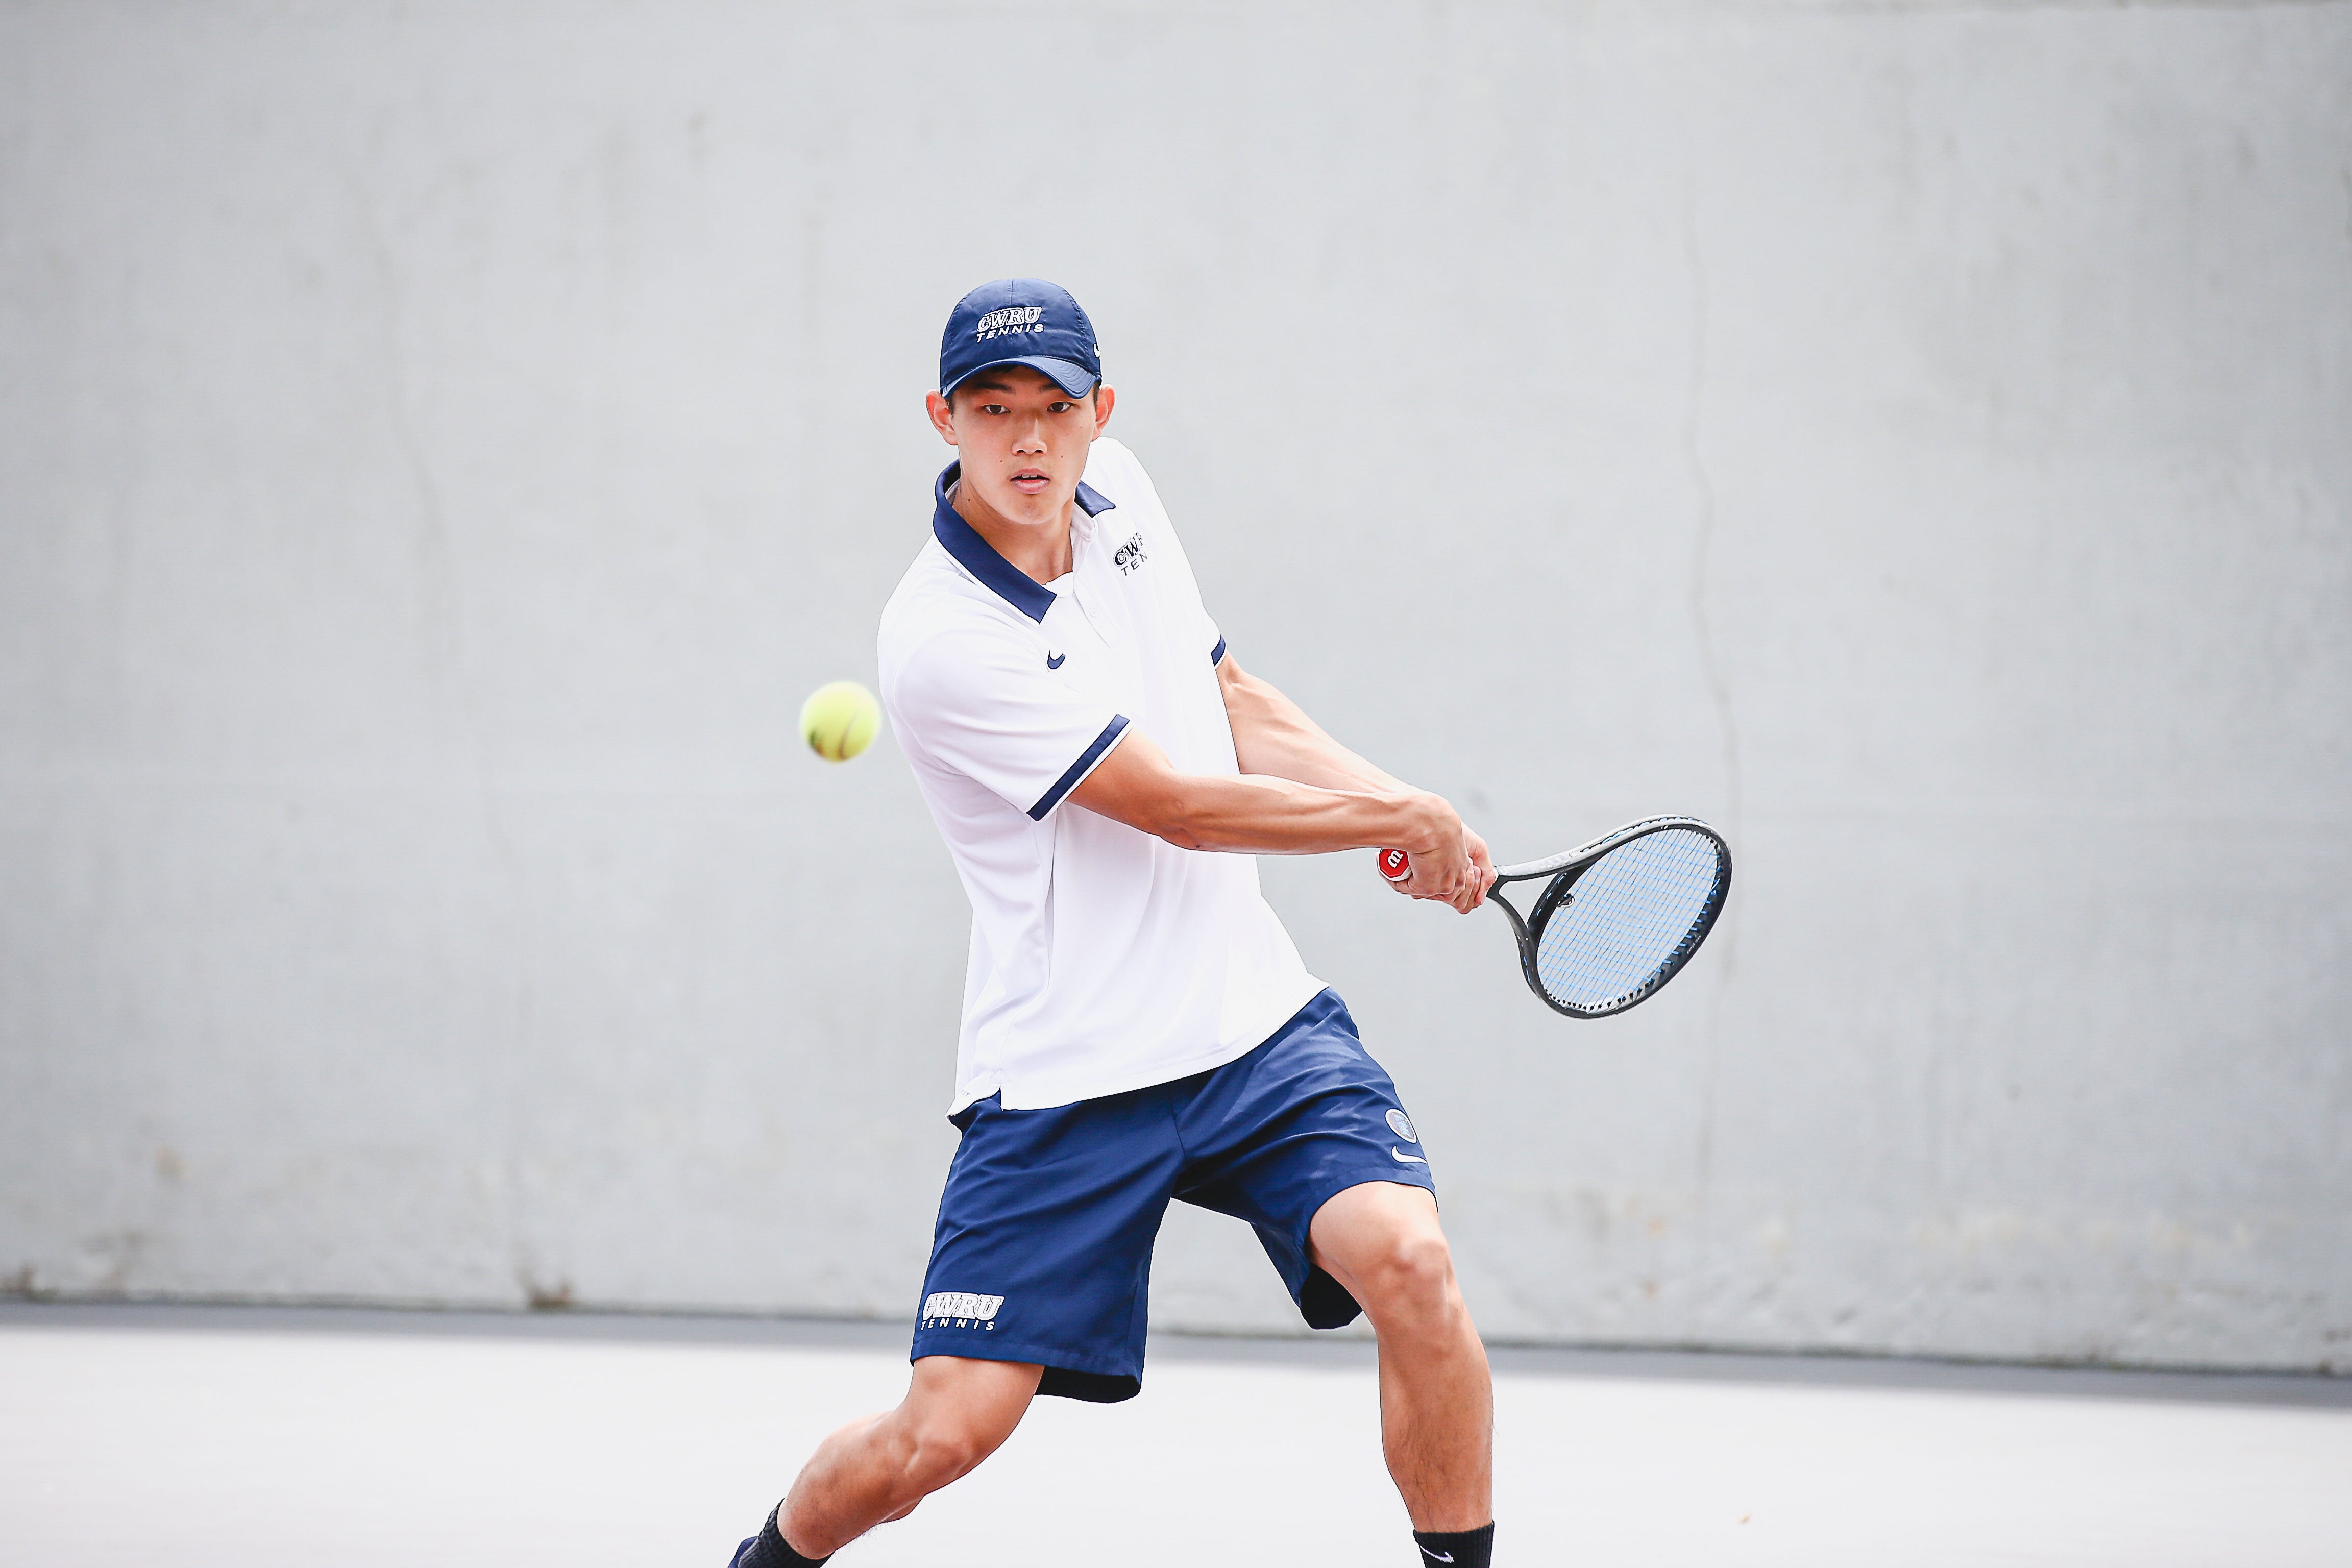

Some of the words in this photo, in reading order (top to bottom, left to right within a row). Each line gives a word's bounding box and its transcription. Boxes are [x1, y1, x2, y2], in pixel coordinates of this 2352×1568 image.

[976, 306, 1043, 332] CWRU
[976, 323, 1044, 343] TENNIS
[922, 1292, 1005, 1320] CWRU
[921, 1318, 995, 1331] TENNIS
